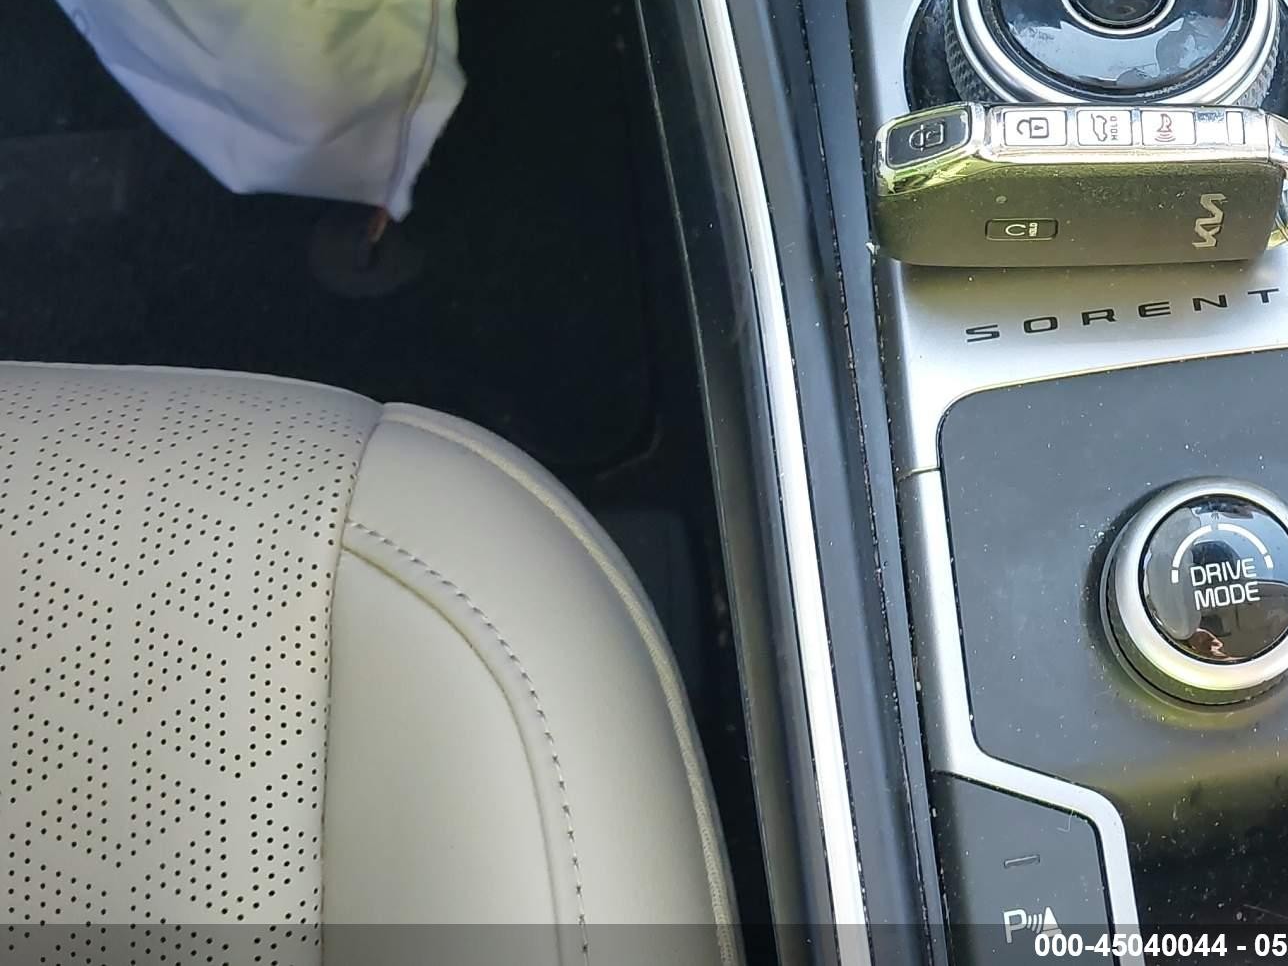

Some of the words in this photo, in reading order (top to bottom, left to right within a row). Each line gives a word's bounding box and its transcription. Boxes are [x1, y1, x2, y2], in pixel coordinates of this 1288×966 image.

[1110, 115, 1118, 141] HOLD
[1190, 557, 1257, 587] DRIVE
[1194, 581, 1261, 611] MODE
[1003, 908, 1027, 944] P
